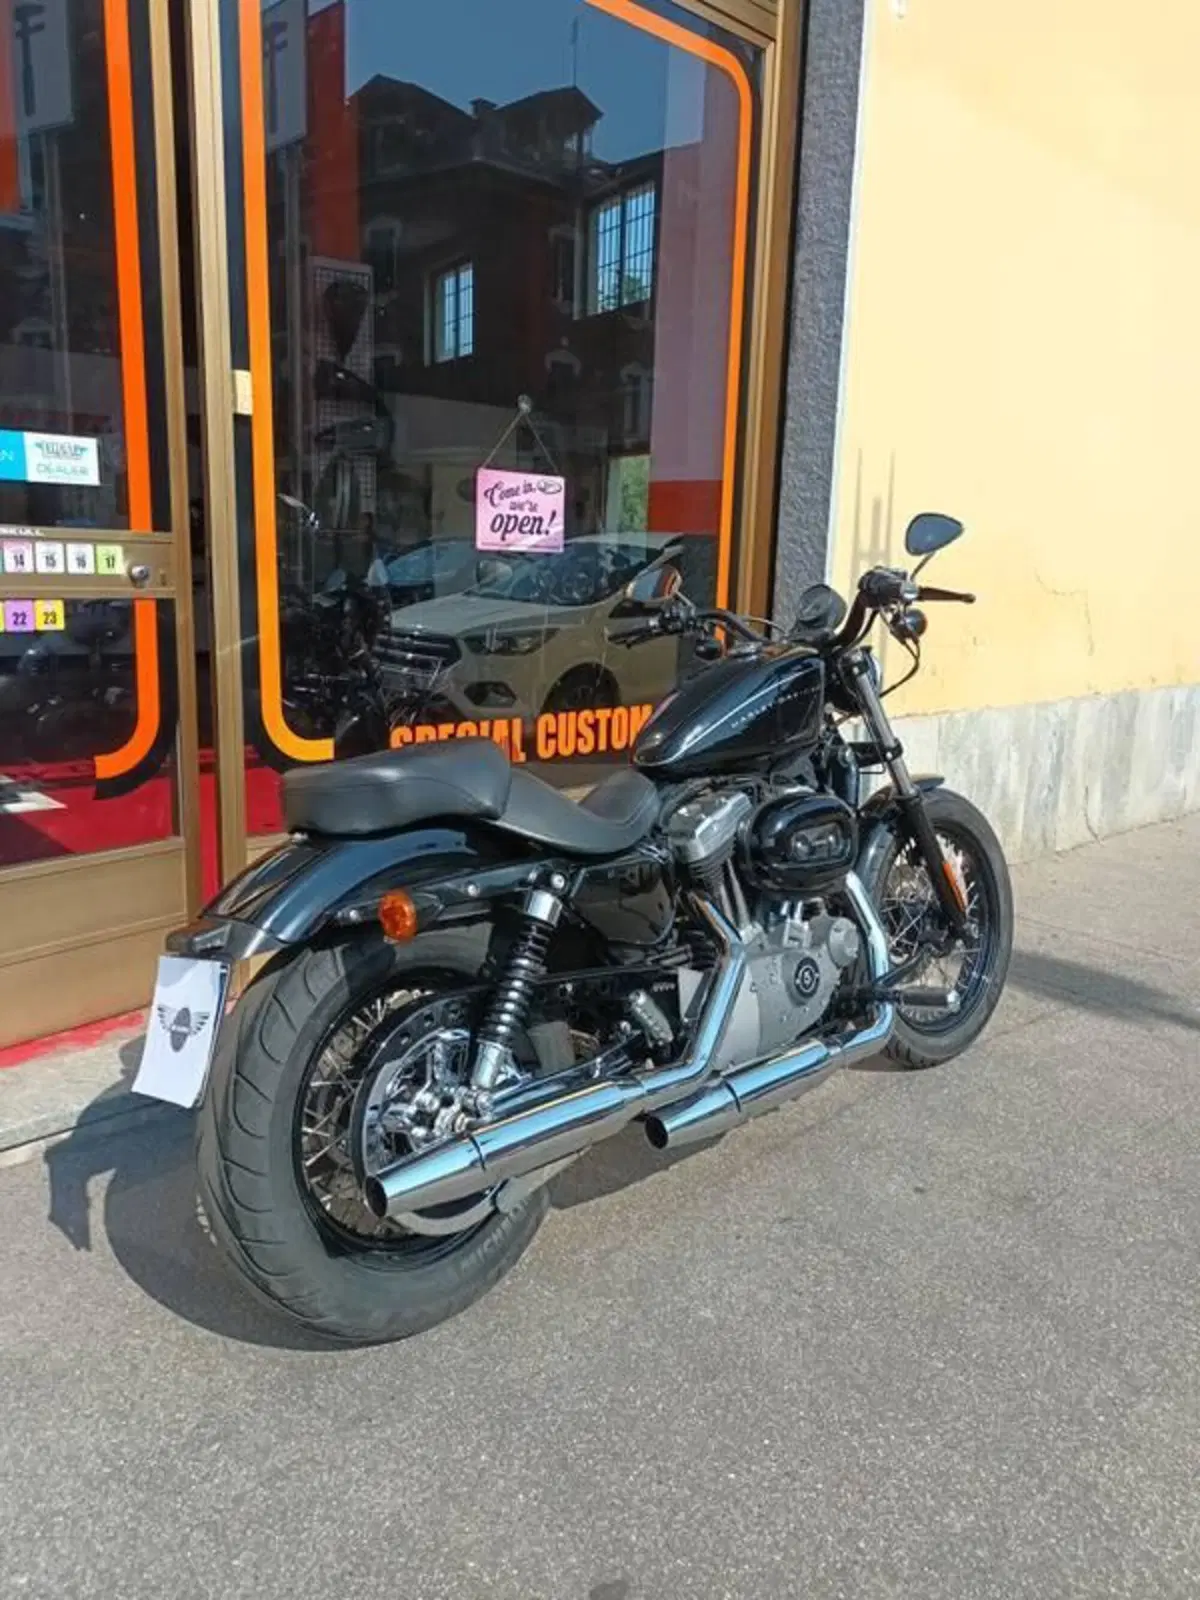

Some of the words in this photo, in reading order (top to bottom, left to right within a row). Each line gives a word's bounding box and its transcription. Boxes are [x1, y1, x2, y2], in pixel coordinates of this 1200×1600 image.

[490, 510, 557, 541] open!
[13, 553, 25, 568] 14
[45, 553, 57, 568] 15
[12, 611, 27, 625] 22
[43, 611, 58, 625] 23
